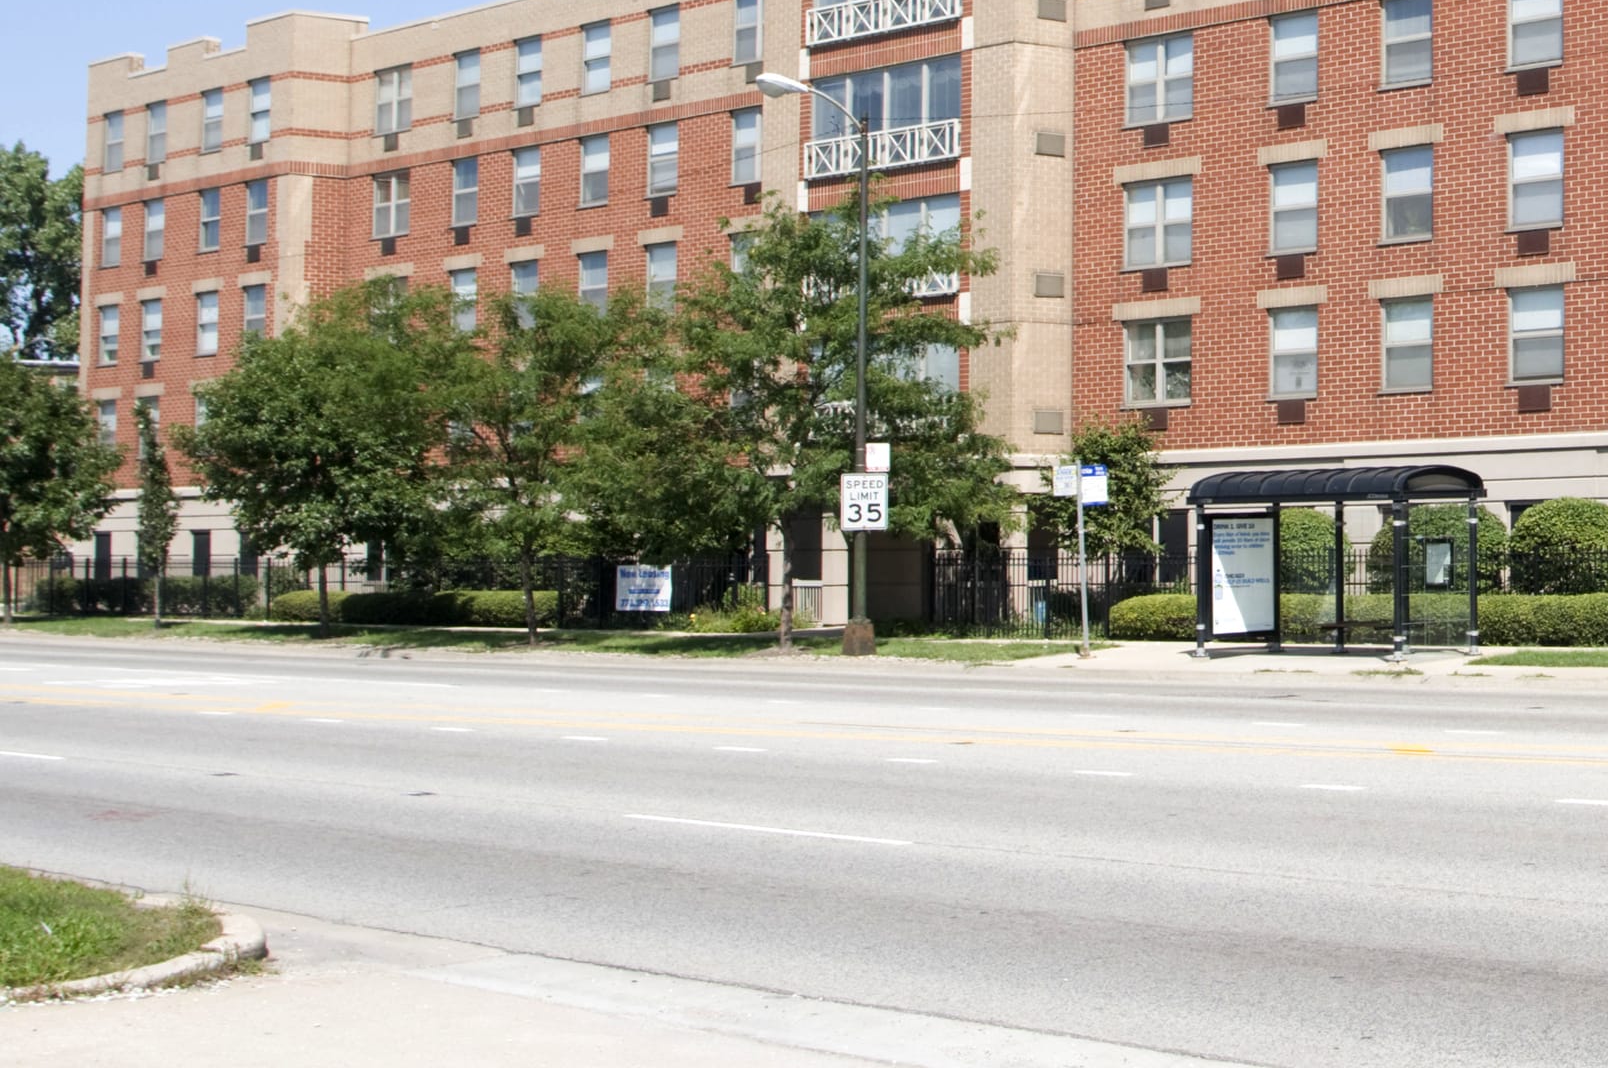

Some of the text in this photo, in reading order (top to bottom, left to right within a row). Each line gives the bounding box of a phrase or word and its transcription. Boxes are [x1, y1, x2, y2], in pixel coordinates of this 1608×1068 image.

[846, 480, 884, 489] SPEED
[850, 491, 879, 501] LIMIT
[847, 503, 882, 523] 35
